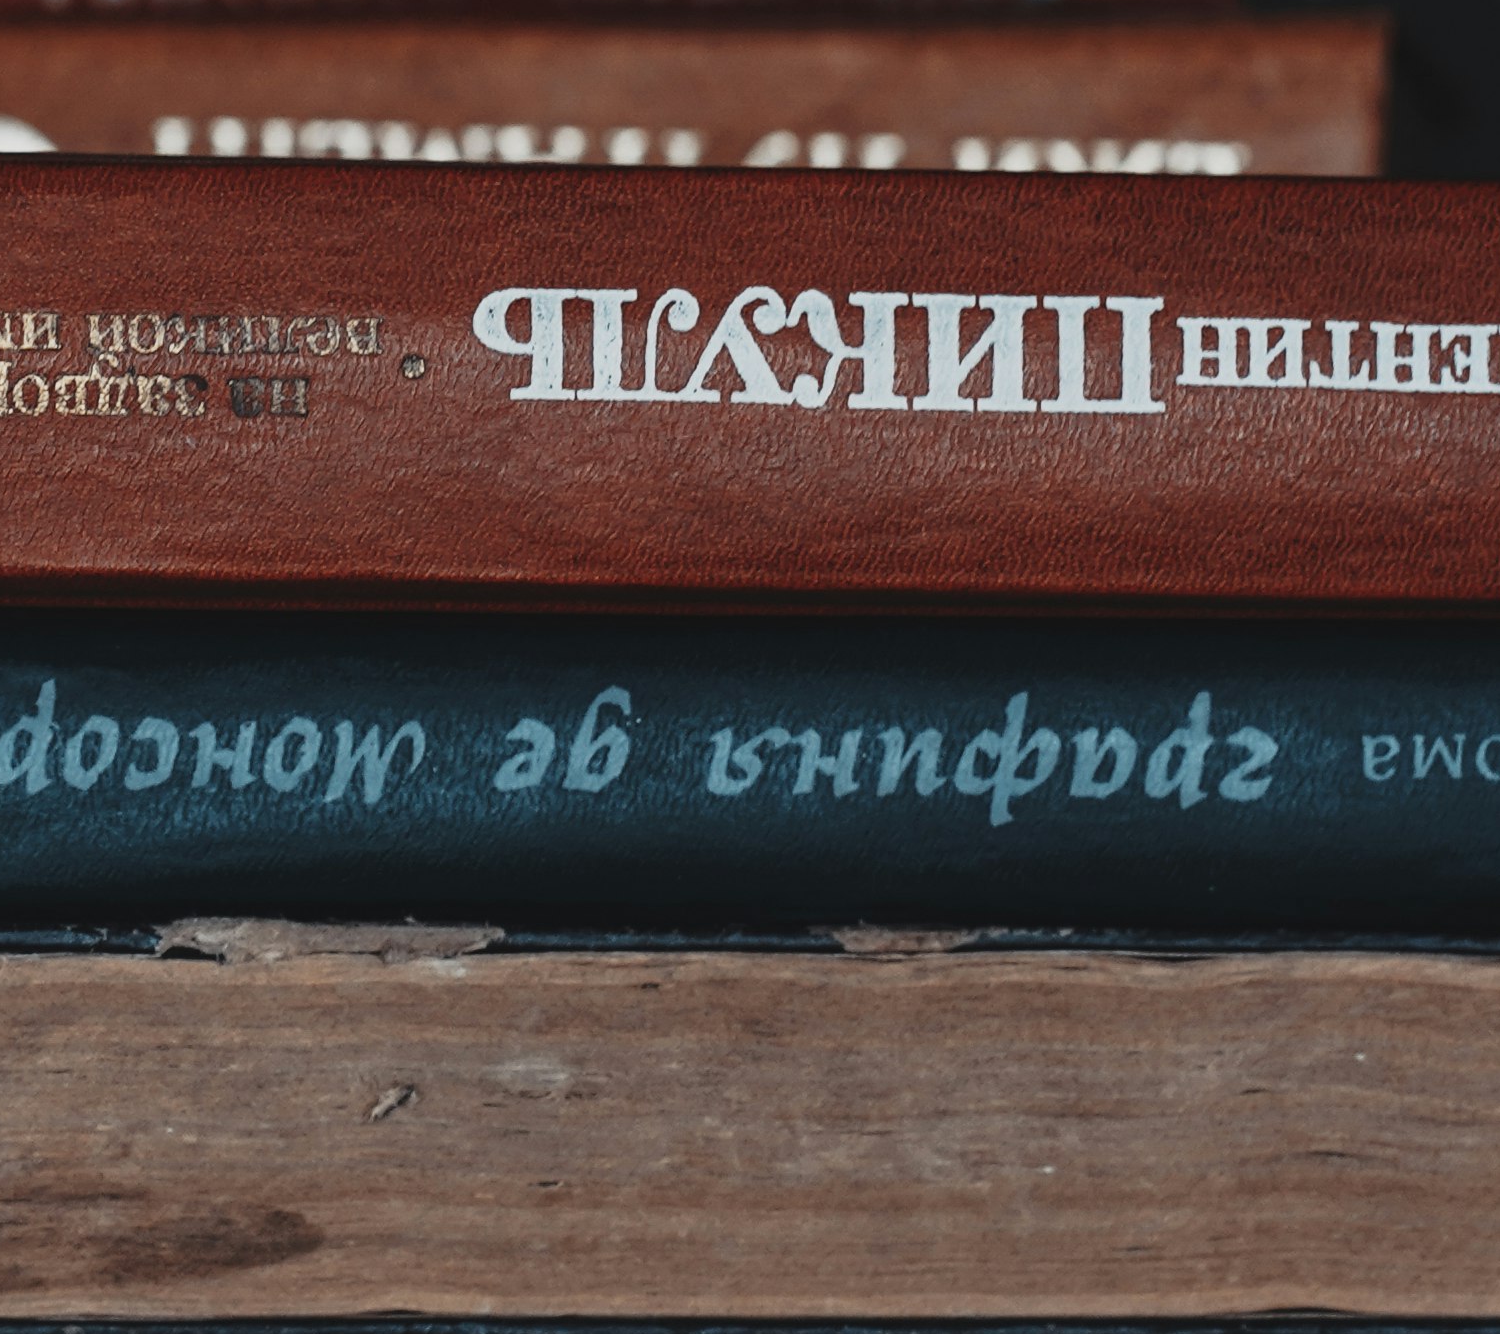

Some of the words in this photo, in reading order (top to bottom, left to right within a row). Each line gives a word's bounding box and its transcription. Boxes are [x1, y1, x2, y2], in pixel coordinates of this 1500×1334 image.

[87, 312, 387, 373] великой
[229, 373, 312, 421] на
[473, 286, 1168, 415] ПИКУЛЬ
[493, 684, 633, 795] де
[704, 689, 1281, 827] графиня
